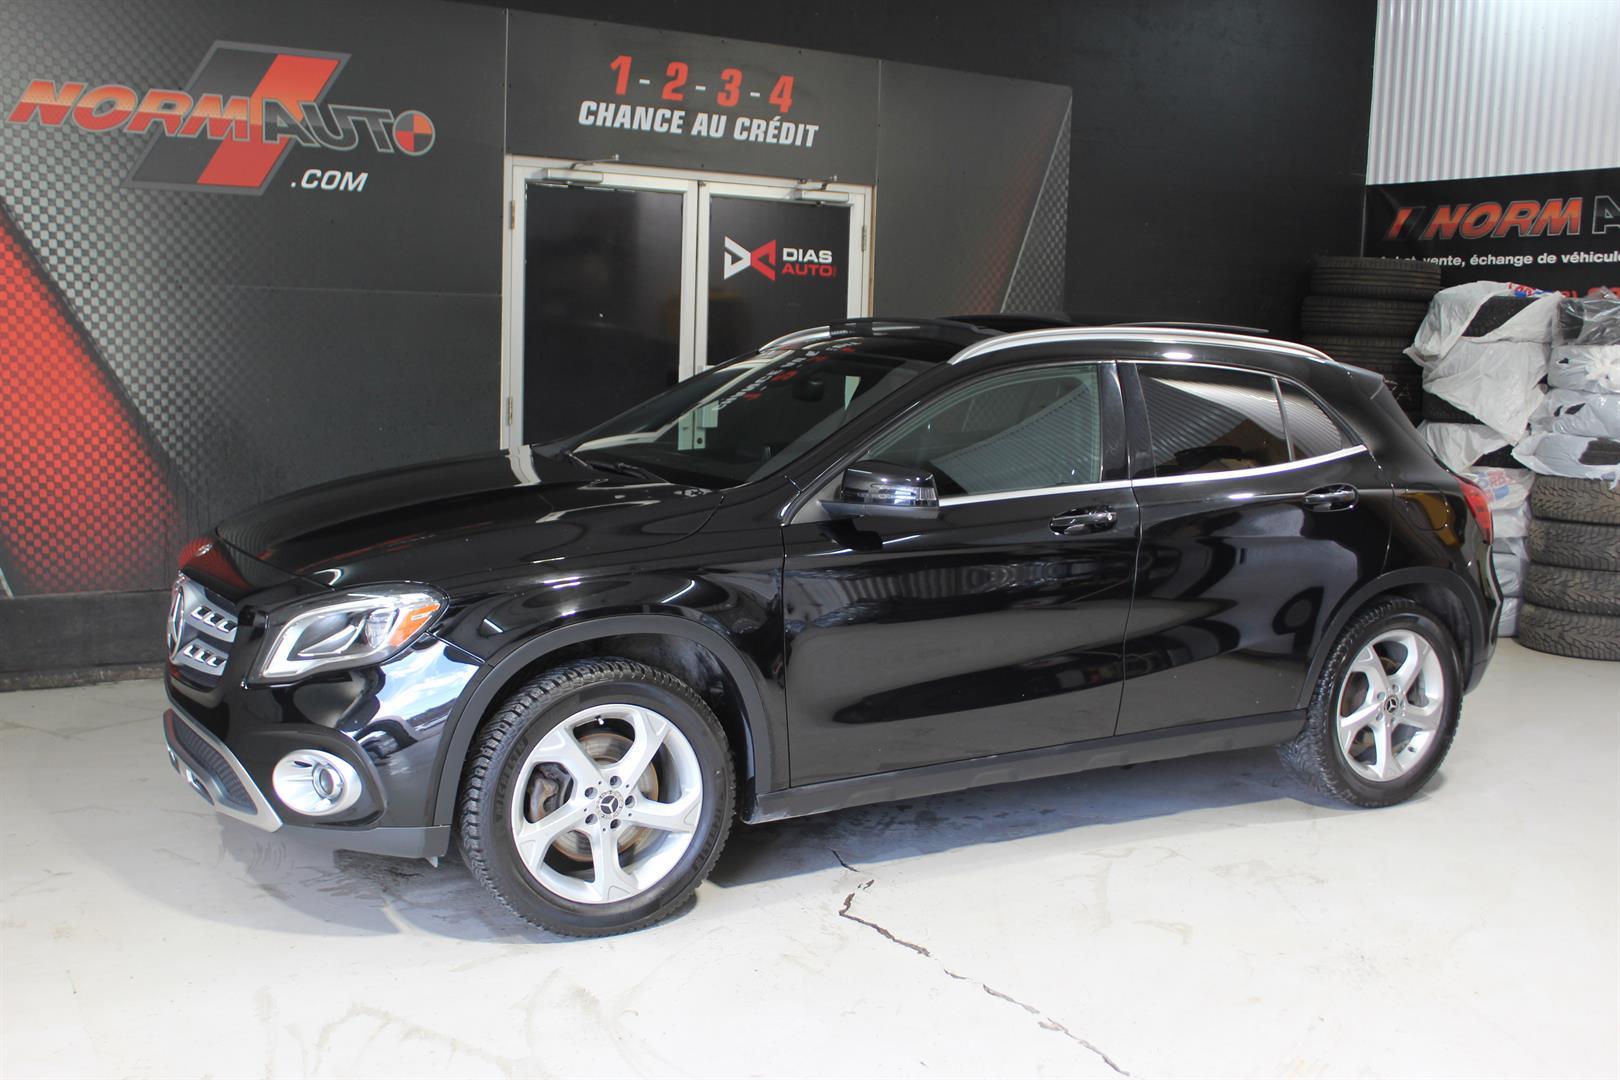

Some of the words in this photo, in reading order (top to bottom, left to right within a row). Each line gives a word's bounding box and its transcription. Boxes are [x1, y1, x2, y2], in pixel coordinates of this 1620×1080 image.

[578, 100, 686, 134] CHANCE
[691, 112, 728, 139] AU
[733, 115, 820, 147] CRÉDIT
[290, 168, 369, 192] .COM
[782, 247, 833, 264] DIAS
[1469, 254, 1534, 267] échange
[1537, 252, 1558, 264] de
[1561, 250, 1620, 264] véhicul
[781, 262, 834, 277] AUTO
